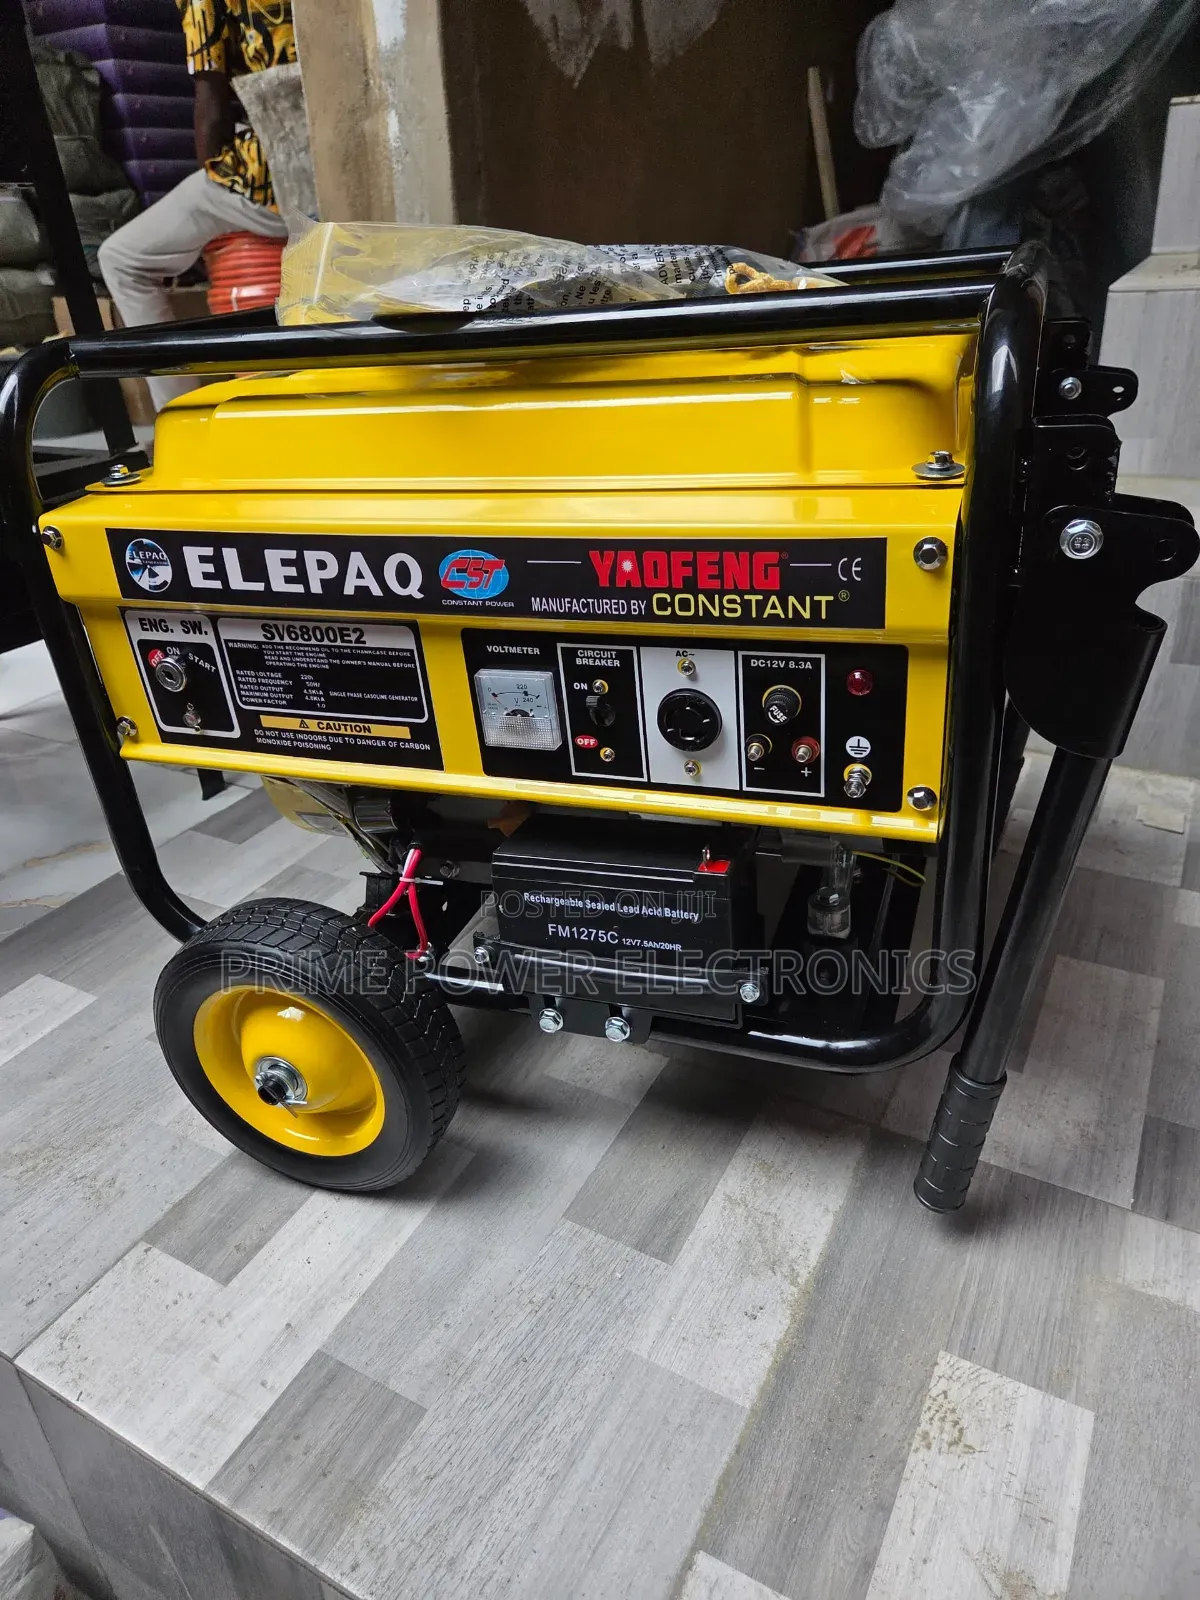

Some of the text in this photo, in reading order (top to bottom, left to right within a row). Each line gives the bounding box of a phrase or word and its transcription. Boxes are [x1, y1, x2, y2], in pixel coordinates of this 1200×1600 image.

[182, 546, 425, 600] ELEPAQ
[441, 599, 514, 608] CONSTANT POWER
[531, 592, 834, 620] MANUFACTURED BY CONSTANT
[138, 617, 209, 636] ENG. SW.
[260, 623, 367, 645] SV6800E2
[166, 646, 180, 655] ON
[486, 645, 541, 655] VOLTMETER
[577, 650, 617, 660] CIRCUIT
[151, 649, 165, 667] OFF
[188, 652, 217, 673] START
[575, 658, 621, 668] BREAKER
[750, 658, 813, 670] DC12V 8.3A
[258, 678, 293, 686] FREQUENCY
[573, 682, 588, 691] ON
[240, 690, 268, 698] MAXIMUM
[270, 692, 294, 700] OUTPUT
[329, 690, 347, 698] SINGLE
[388, 694, 418, 702] GENERATOR
[769, 705, 788, 722] FUSE
[317, 721, 372, 734] CAUTION
[256, 737, 332, 751] MONOXIDE POISONING
[296, 733, 328, 742] INDOORS
[328, 736, 344, 744] DUE
[356, 738, 387, 747] DANGER
[388, 740, 398, 748] OF
[399, 742, 431, 750] CARBON
[577, 737, 597, 746] OFF
[523, 892, 700, 923] Rechargeable Sealed Lead Acid Battery
[548, 923, 683, 952] FM1275C 12V7.5Ah/20HR
